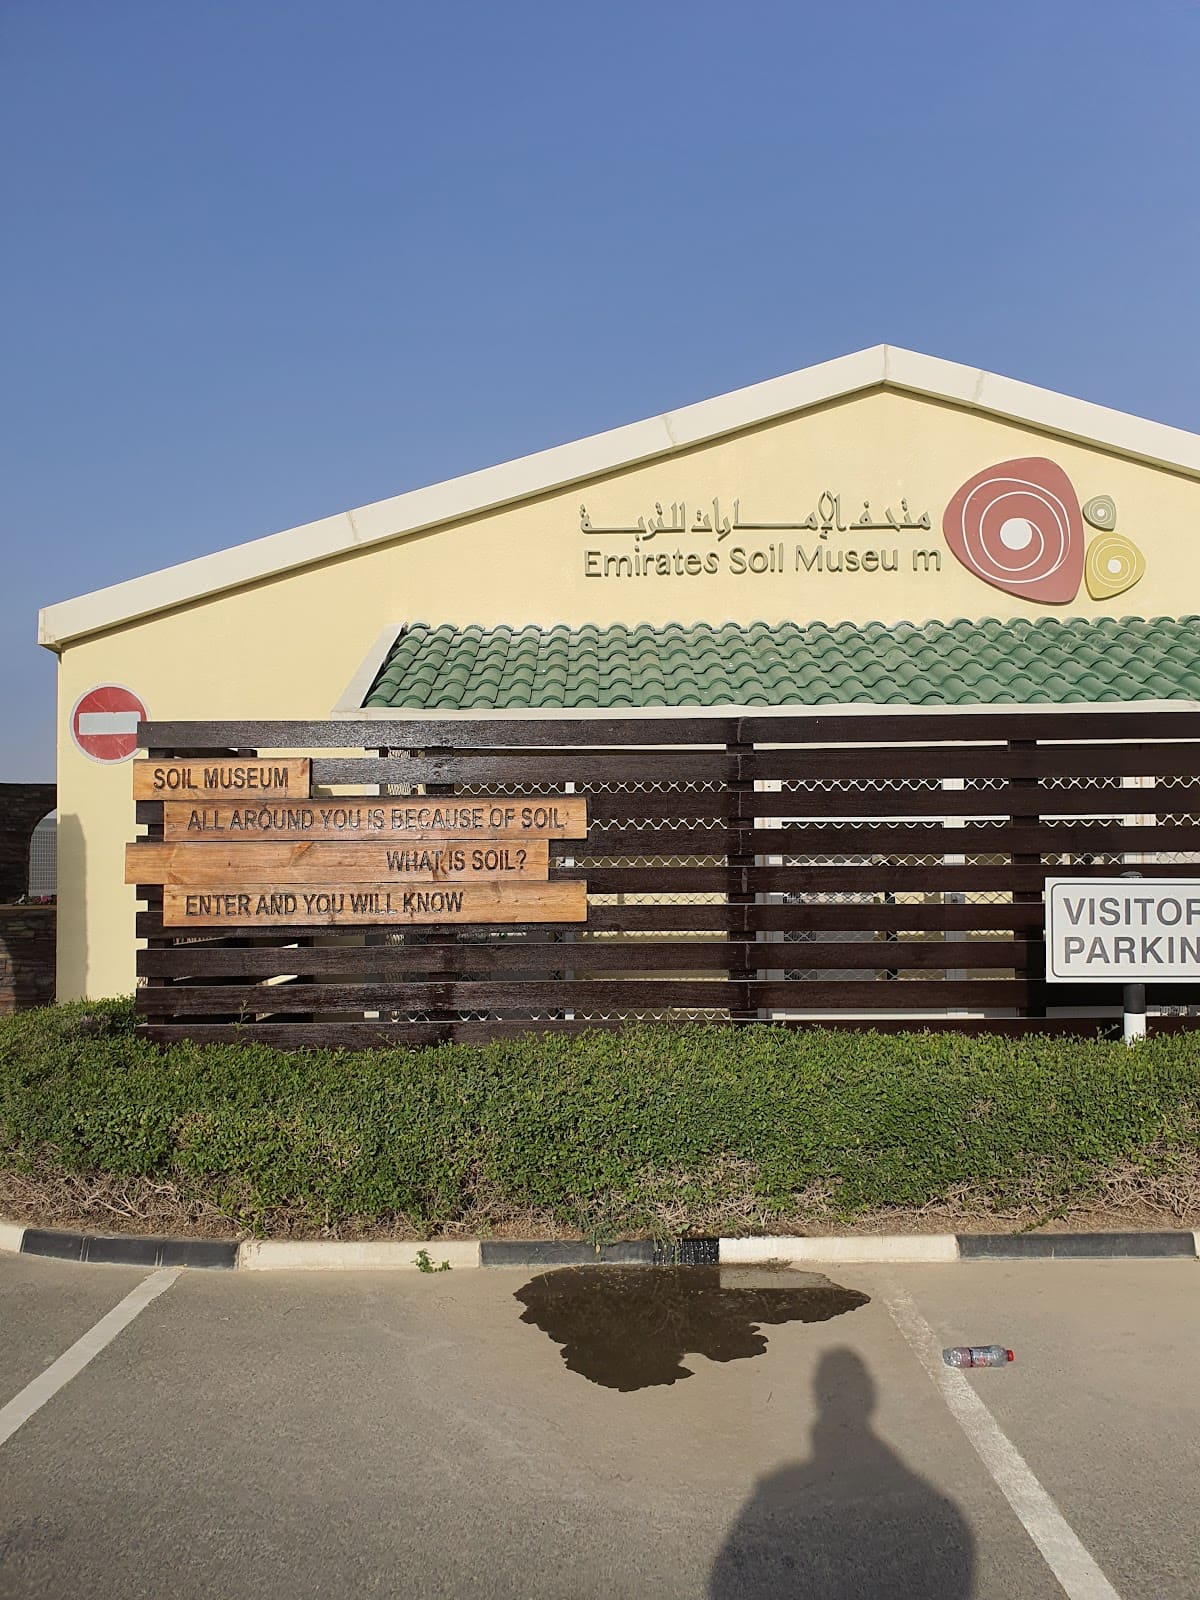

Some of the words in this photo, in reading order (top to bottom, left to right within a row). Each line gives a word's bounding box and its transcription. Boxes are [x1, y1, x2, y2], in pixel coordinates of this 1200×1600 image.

[579, 500, 687, 542] للتربة
[849, 497, 932, 533] متحف
[584, 545, 720, 578] Emirates
[729, 543, 784, 575] Soil
[153, 767, 198, 790] SOIL
[203, 767, 289, 789] MUSEUM
[187, 809, 225, 832] ALL
[230, 808, 315, 832] AROUND
[319, 808, 362, 831] YOU
[367, 808, 385, 831] IS
[391, 807, 485, 831] BECAUSE
[489, 807, 516, 830] OF
[521, 806, 566, 830] SOIL
[386, 849, 444, 872] WHAT
[448, 849, 466, 871] IS
[471, 848, 528, 871] SOIL?
[185, 893, 251, 917] ENTER
[254, 893, 298, 916] AND
[302, 892, 345, 917] YOU
[350, 891, 398, 915] WILL
[402, 890, 464, 914] KNOW
